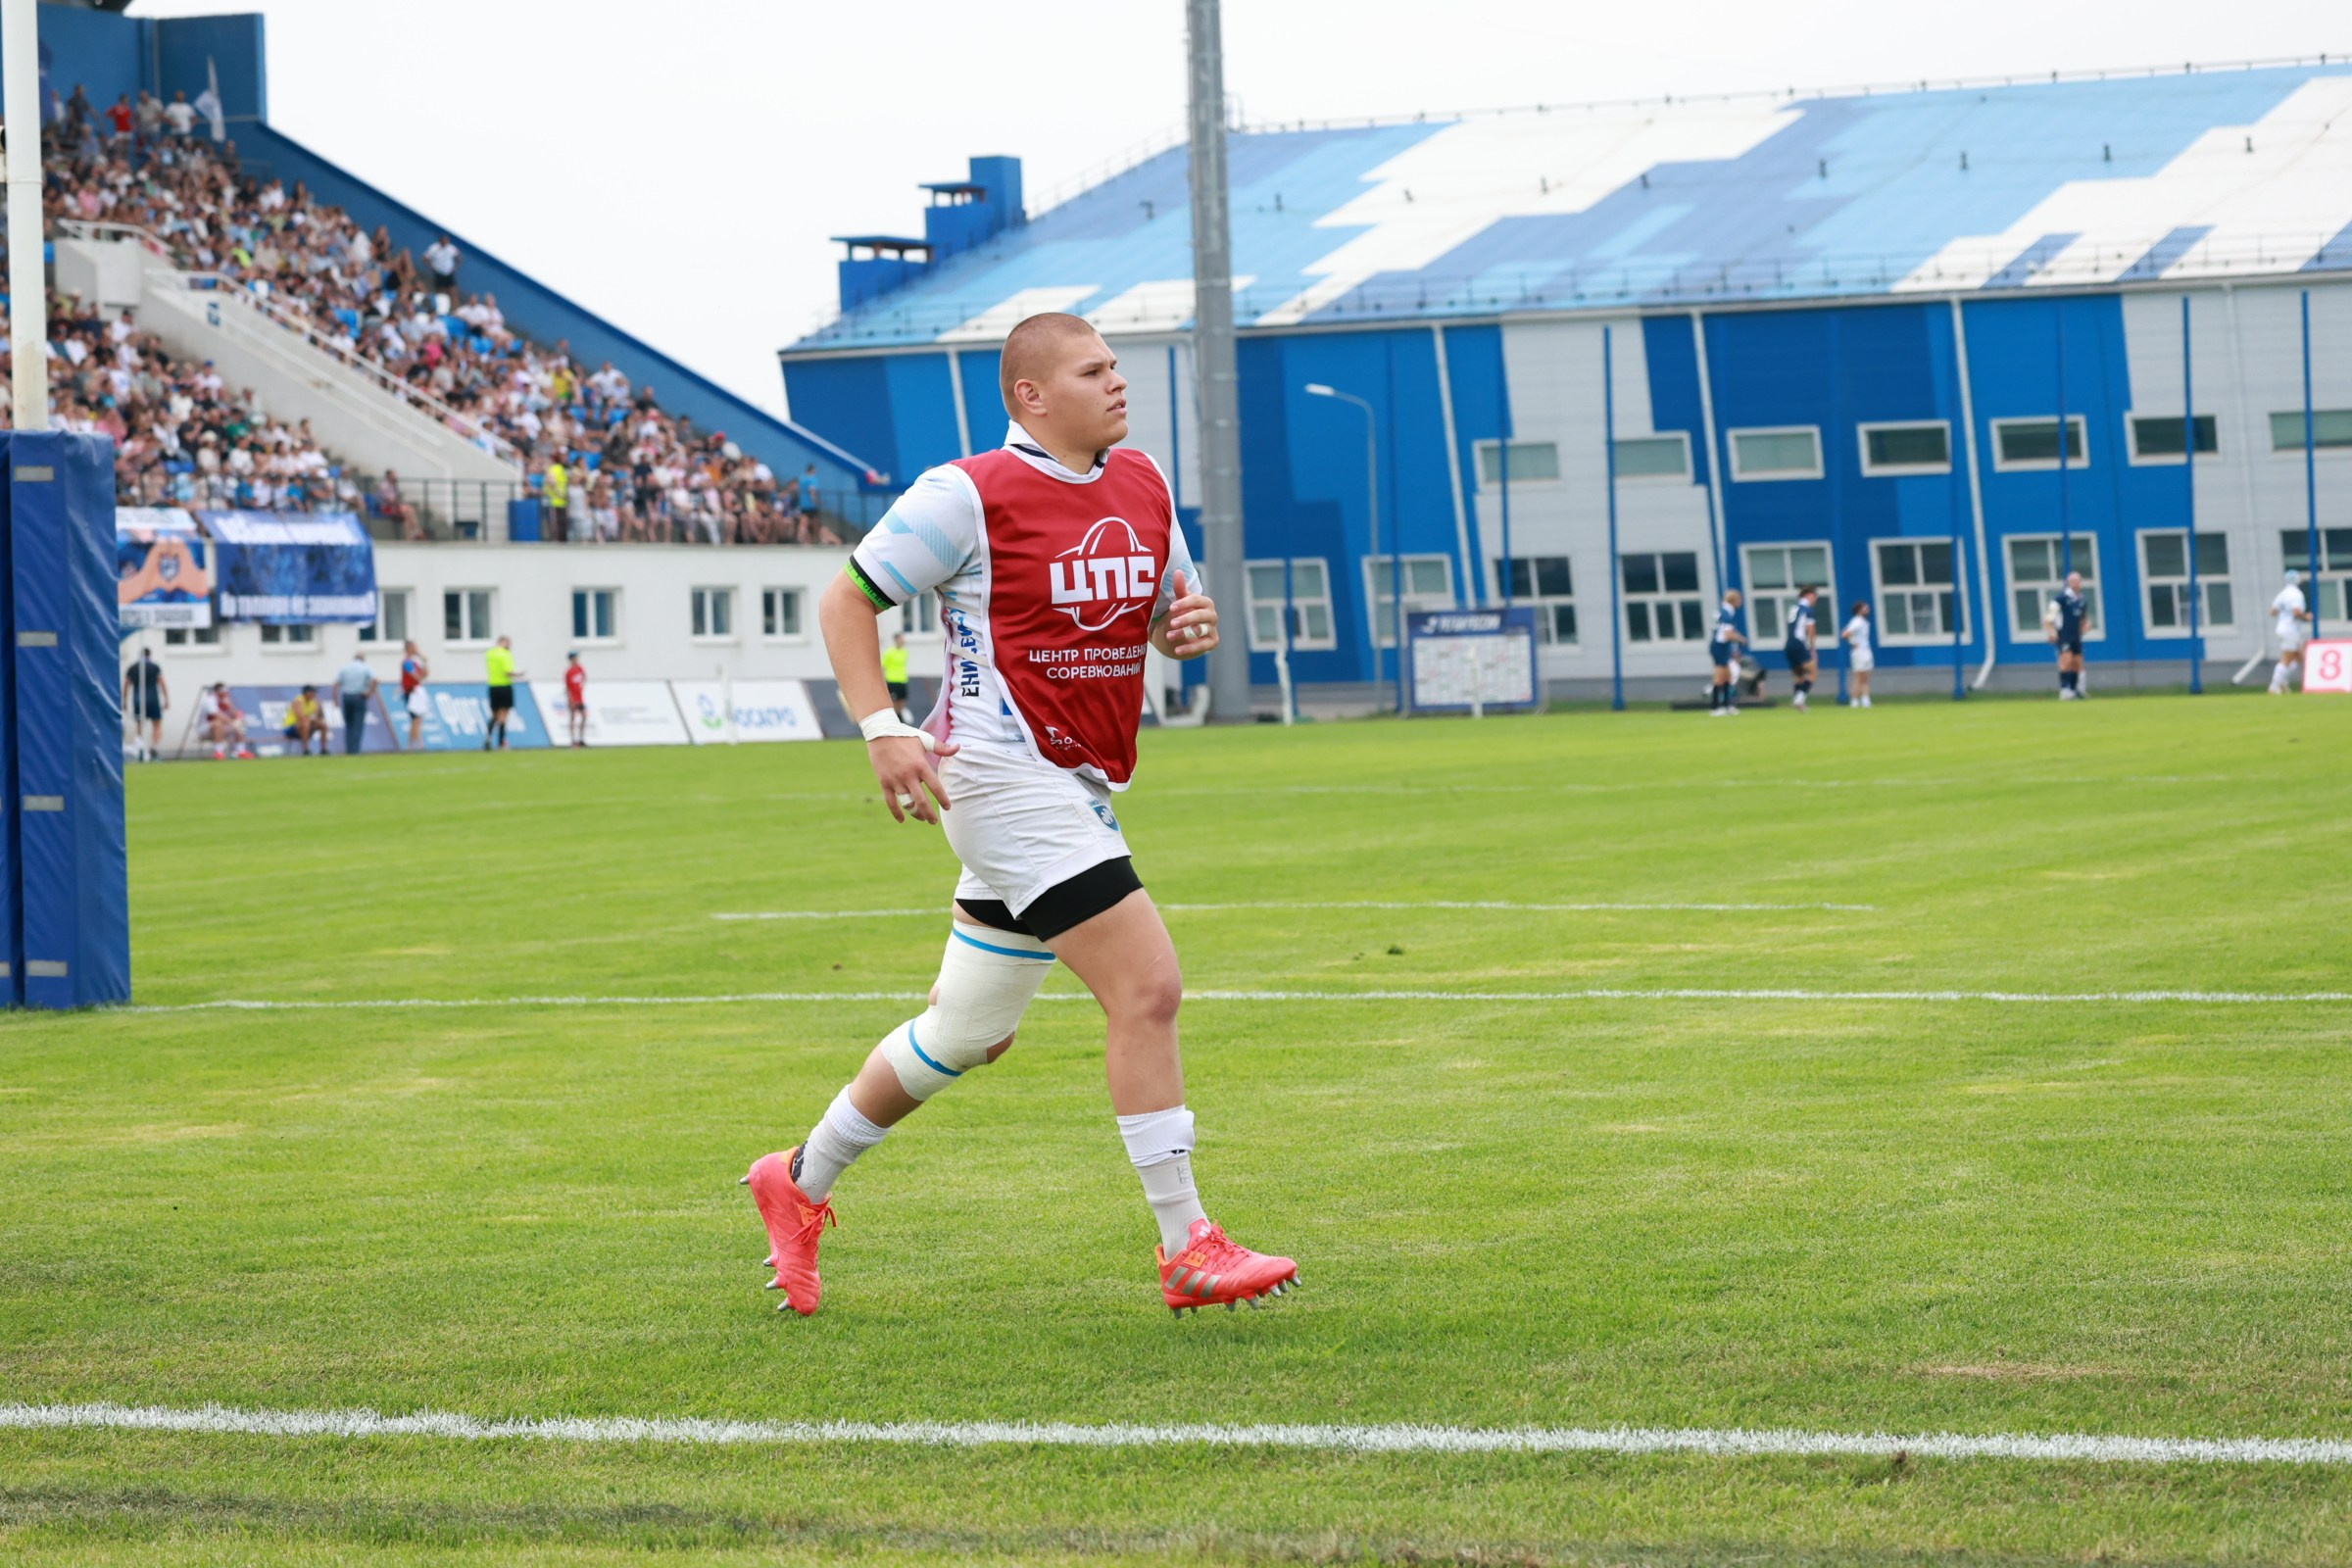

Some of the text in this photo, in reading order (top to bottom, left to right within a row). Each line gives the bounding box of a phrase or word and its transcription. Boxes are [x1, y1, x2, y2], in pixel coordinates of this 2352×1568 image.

[1049, 555, 1156, 605] ЦПС
[1028, 643, 1148, 663] ЦЕНТР ПРОВЕДЕНИ
[2319, 649, 2342, 680] 8
[1046, 660, 1142, 679] СОРЕВНОВАНИЙ
